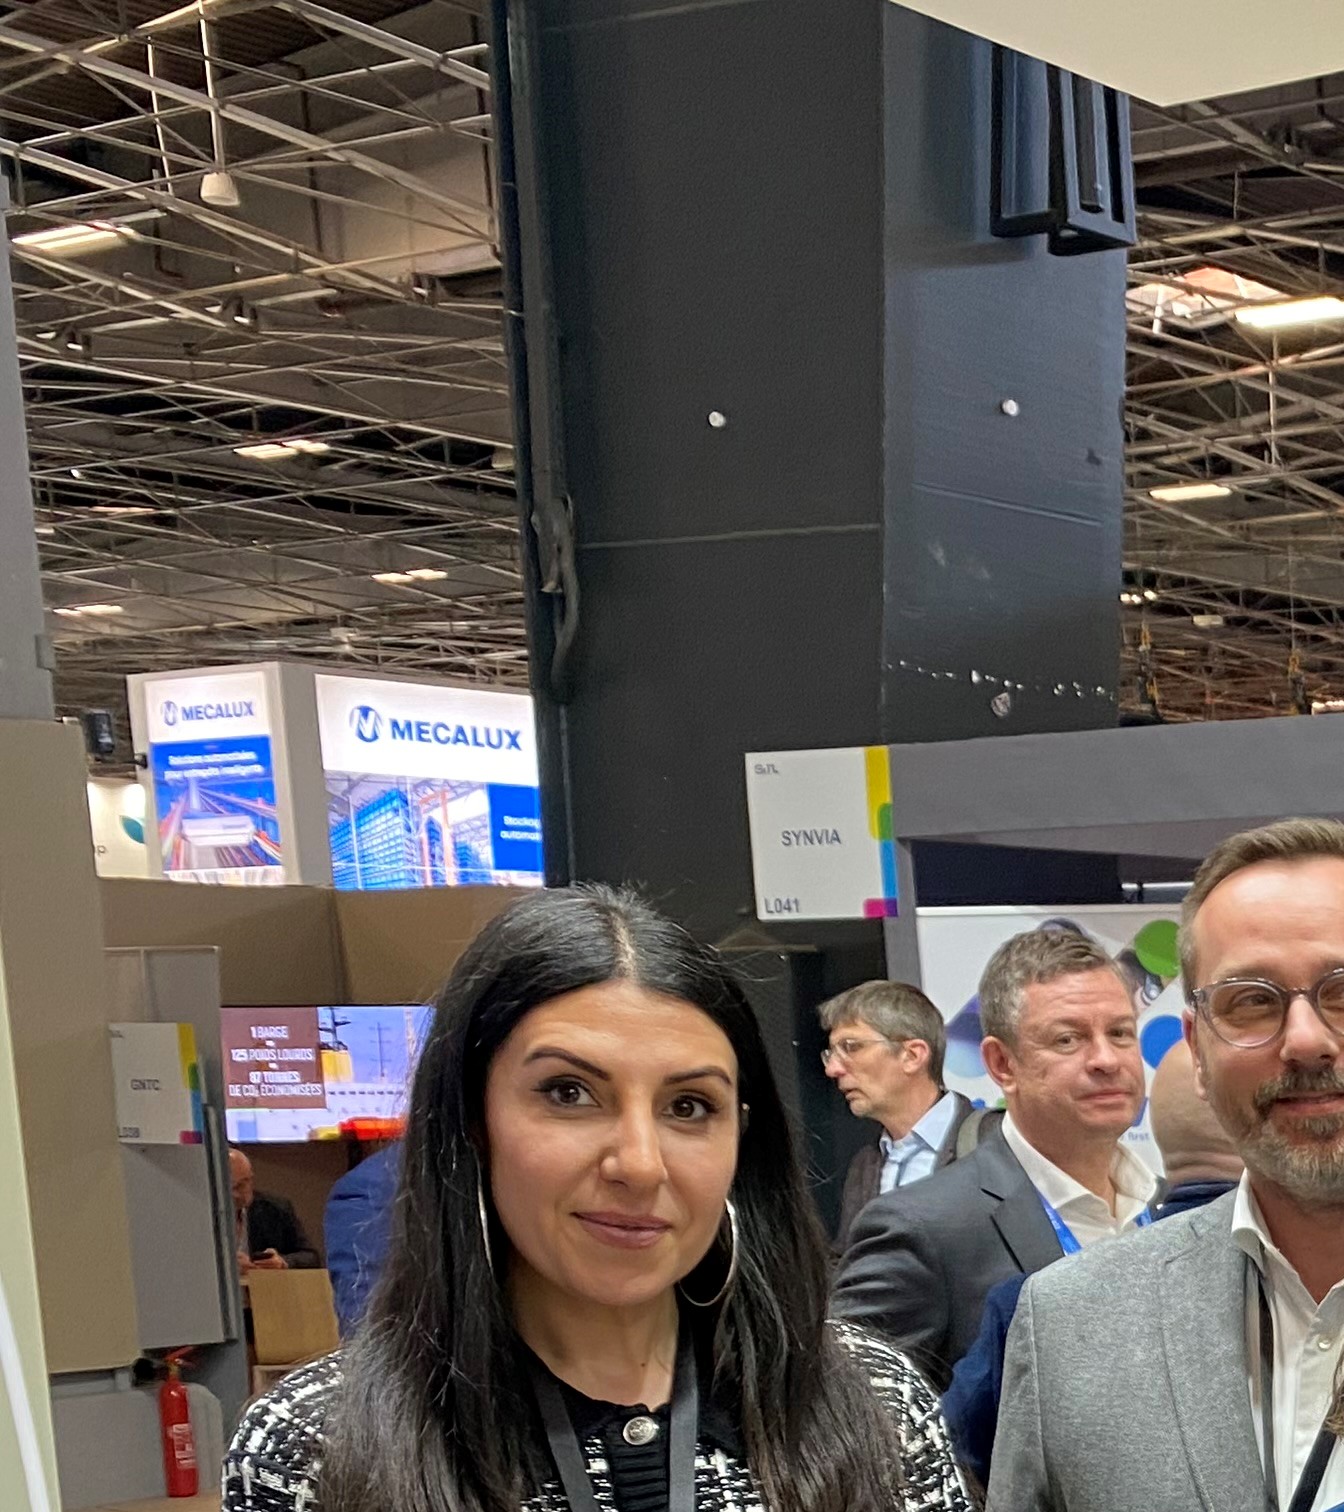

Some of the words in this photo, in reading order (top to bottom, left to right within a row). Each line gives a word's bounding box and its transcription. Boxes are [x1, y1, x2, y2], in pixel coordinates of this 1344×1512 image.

[181, 701, 255, 721] MECALUX
[389, 718, 523, 751] MECALUX
[781, 829, 842, 847] SYNVIA
[764, 898, 800, 914] L041
